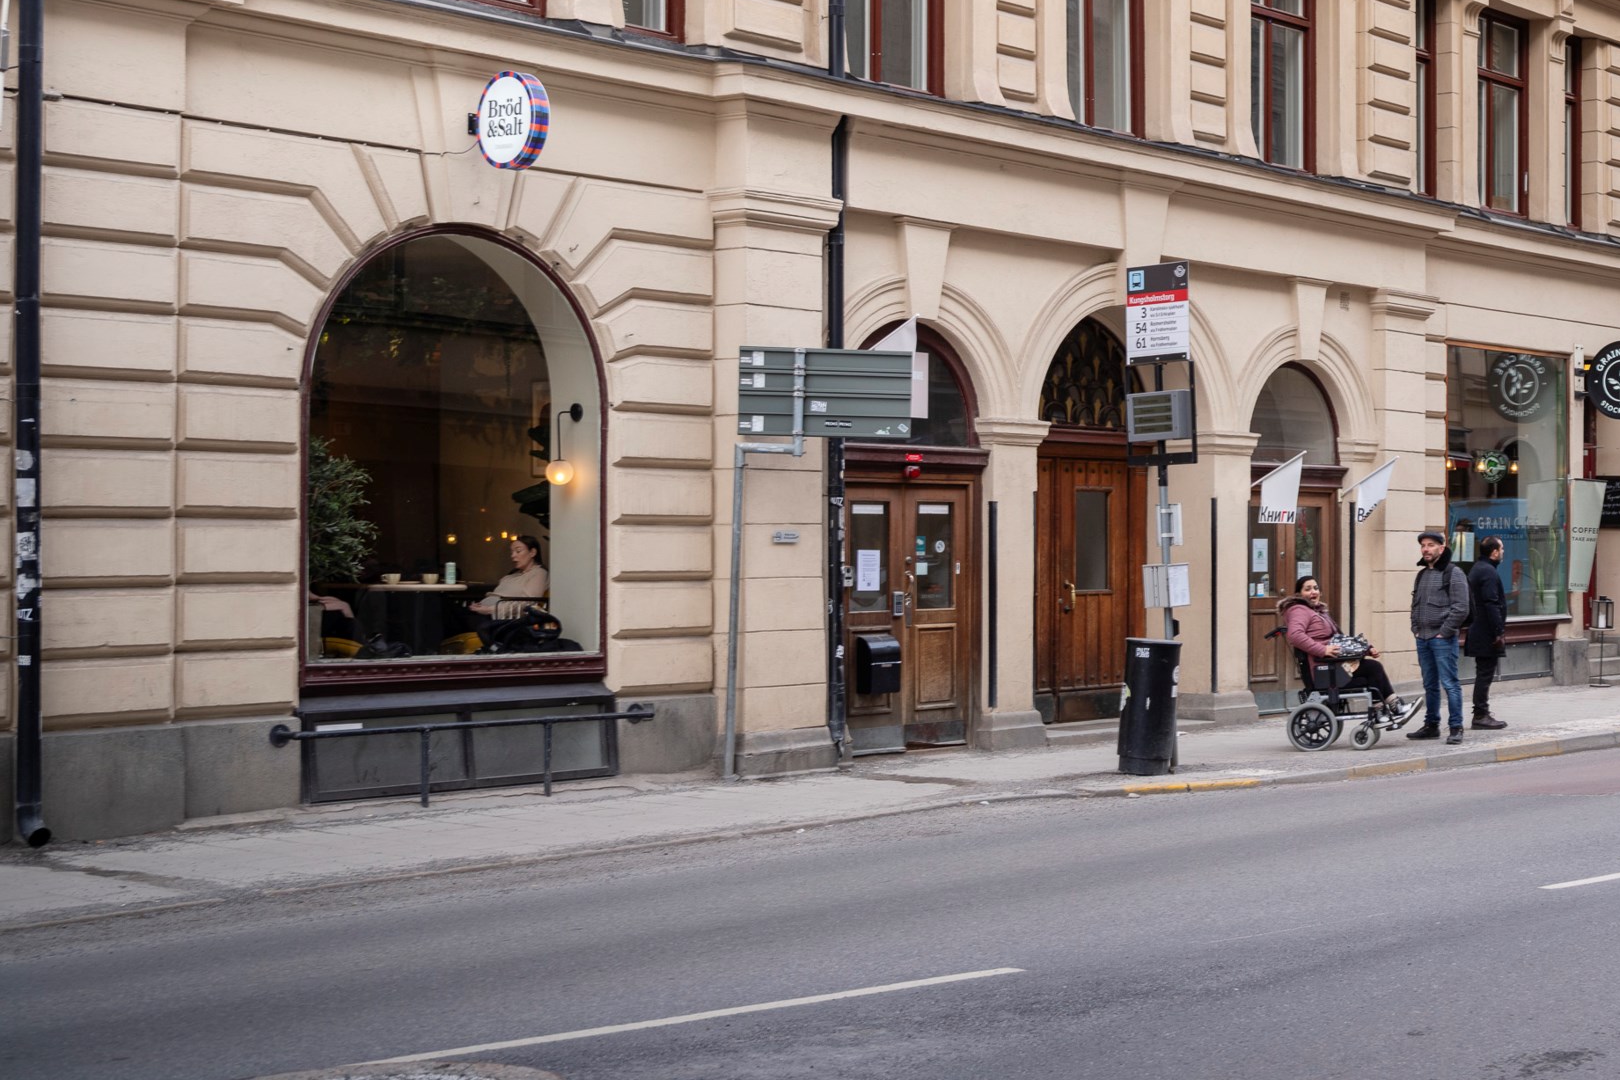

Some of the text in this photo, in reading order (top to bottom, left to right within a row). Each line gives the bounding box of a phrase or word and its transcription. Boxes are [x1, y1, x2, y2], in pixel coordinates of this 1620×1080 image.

[488, 97, 522, 118] Bröd
[487, 117, 523, 138] &Salt
[1141, 307, 1147, 318] 3
[1136, 322, 1147, 334] 54
[1136, 337, 1147, 349] 61
[1260, 506, 1295, 523] Книги
[1477, 517, 1511, 530] GRAIN
[1572, 527, 1599, 535] COFFEE
